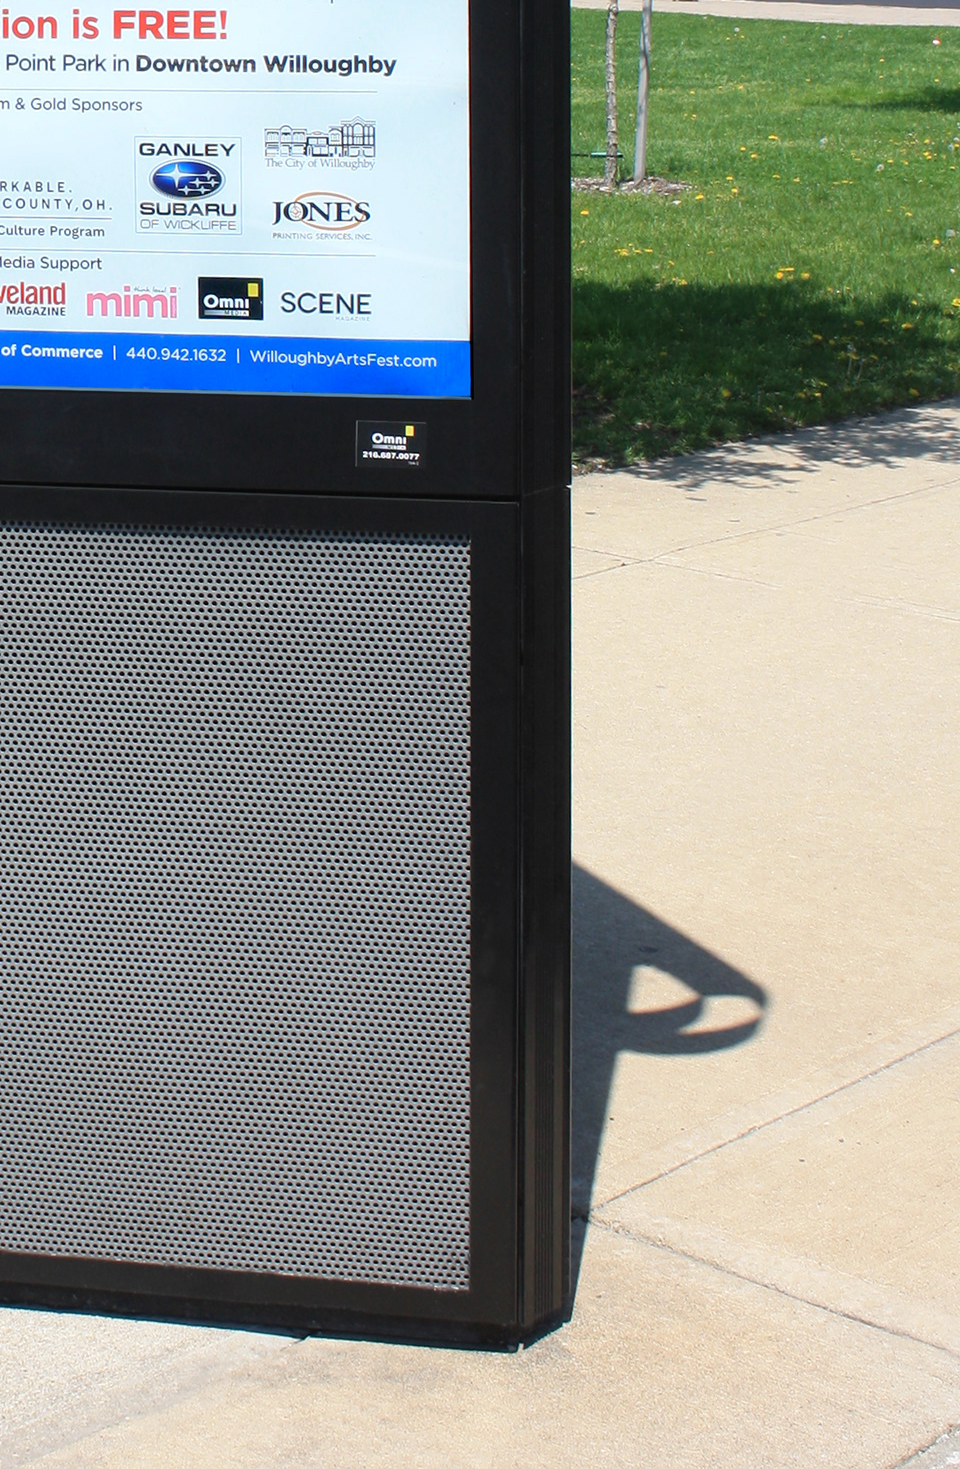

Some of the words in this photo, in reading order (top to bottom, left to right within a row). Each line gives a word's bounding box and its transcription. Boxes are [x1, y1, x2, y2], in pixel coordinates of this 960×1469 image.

[73, 9, 100, 39] is
[113, 10, 228, 39] FREE!
[6, 54, 55, 72] Point
[63, 54, 107, 72] Park
[113, 54, 129, 72] in
[136, 54, 256, 73] Downtown
[263, 55, 397, 77] Willoughby
[15, 97, 26, 110] &
[31, 97, 67, 111] Gold
[71, 98, 143, 113] Sponsors
[139, 142, 237, 157] GANLEY
[265, 158, 283, 168] The
[285, 158, 305, 170] City
[308, 158, 319, 168] of
[320, 158, 376, 171] Willoughby
[139, 202, 237, 217] SUBARU
[272, 201, 371, 225] JONES
[50, 225, 105, 239] Program
[140, 219, 159, 230] OF
[272, 232, 313, 240] PRINTING
[355, 233, 373, 241] INC.
[40, 256, 102, 271] Support
[86, 285, 177, 319] mimi
[203, 294, 250, 309] Omni
[280, 291, 372, 315] SCENE
[6, 306, 66, 317] MAGAZINE
[0, 342, 17, 357] of
[21, 344, 104, 360] Commerce
[126, 346, 227, 363] 440.942.1632
[250, 349, 437, 369] WilloughbyArtsFest.com
[371, 432, 406, 444] Omni
